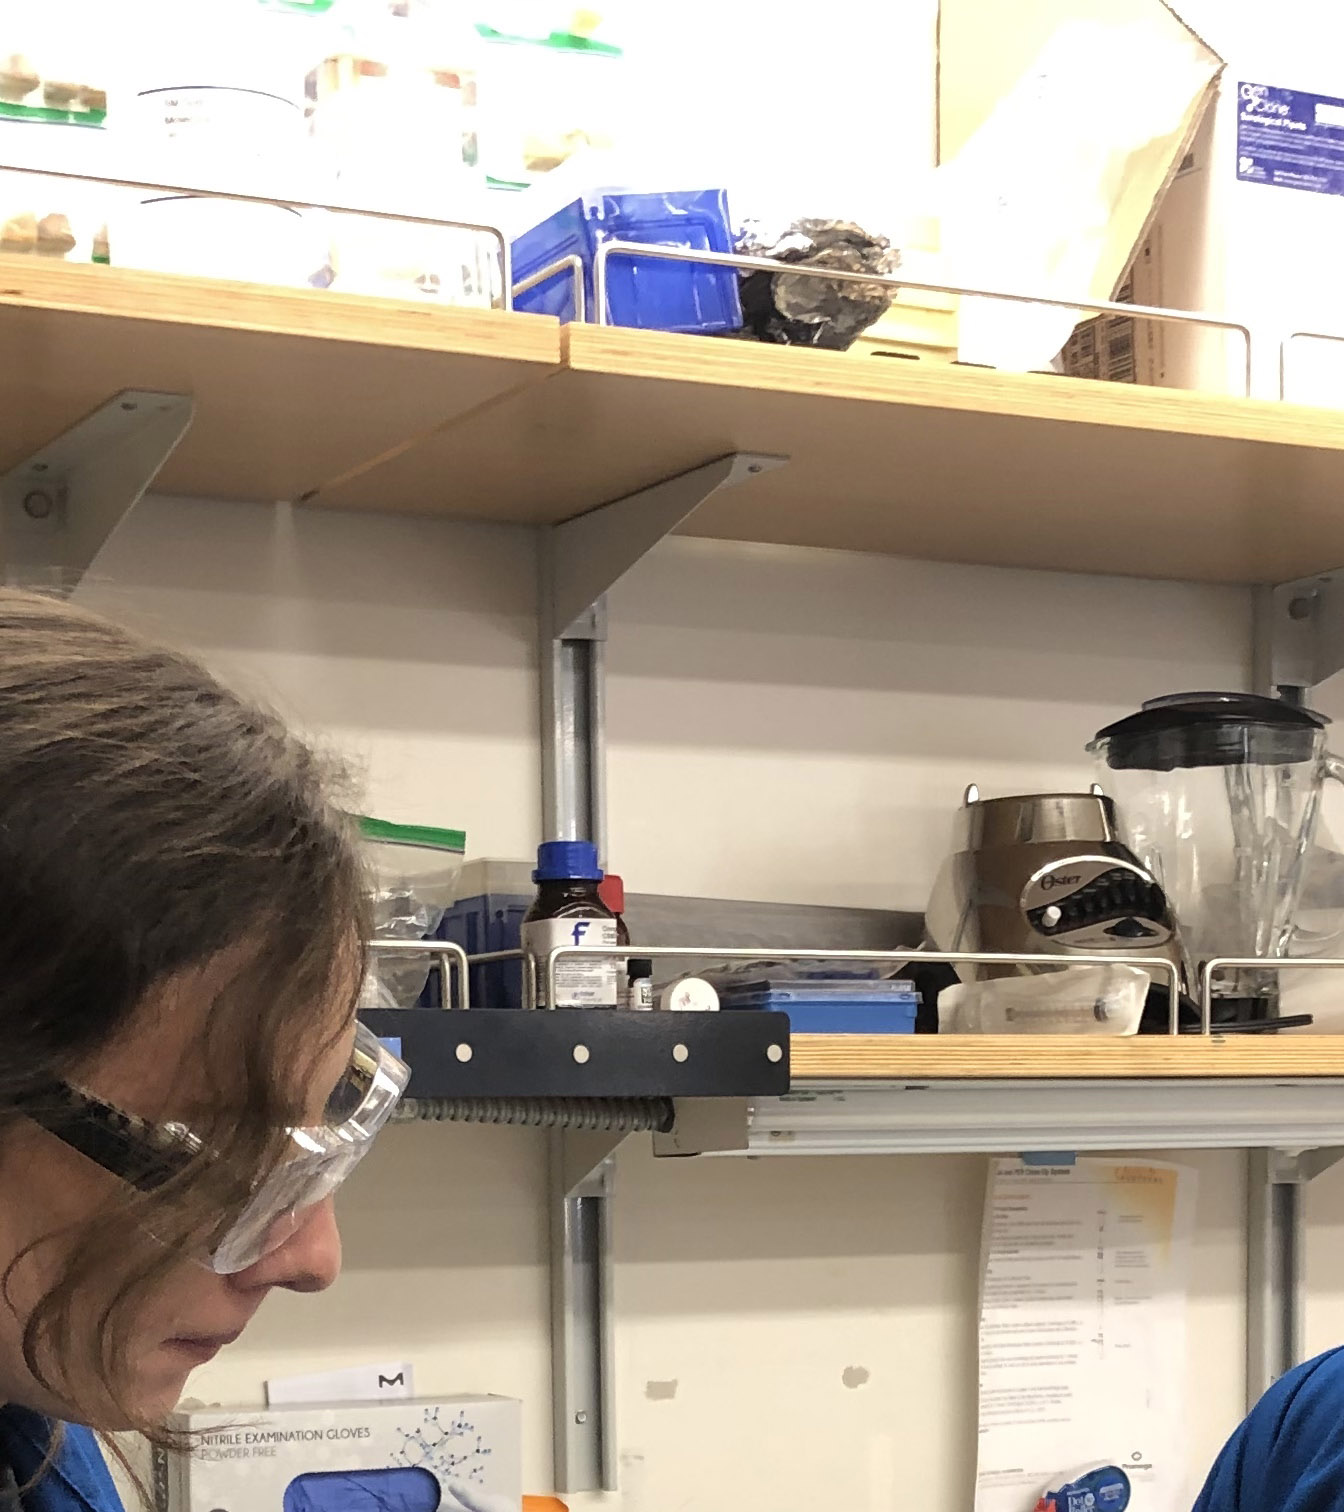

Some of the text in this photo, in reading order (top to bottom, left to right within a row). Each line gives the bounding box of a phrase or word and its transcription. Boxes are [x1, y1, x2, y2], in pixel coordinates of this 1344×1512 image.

[1040, 873, 1081, 891] Oster
[200, 1427, 371, 1446] NITRILE EXAMINATION GLOVES
[201, 1446, 277, 1460] POWDER FREE
